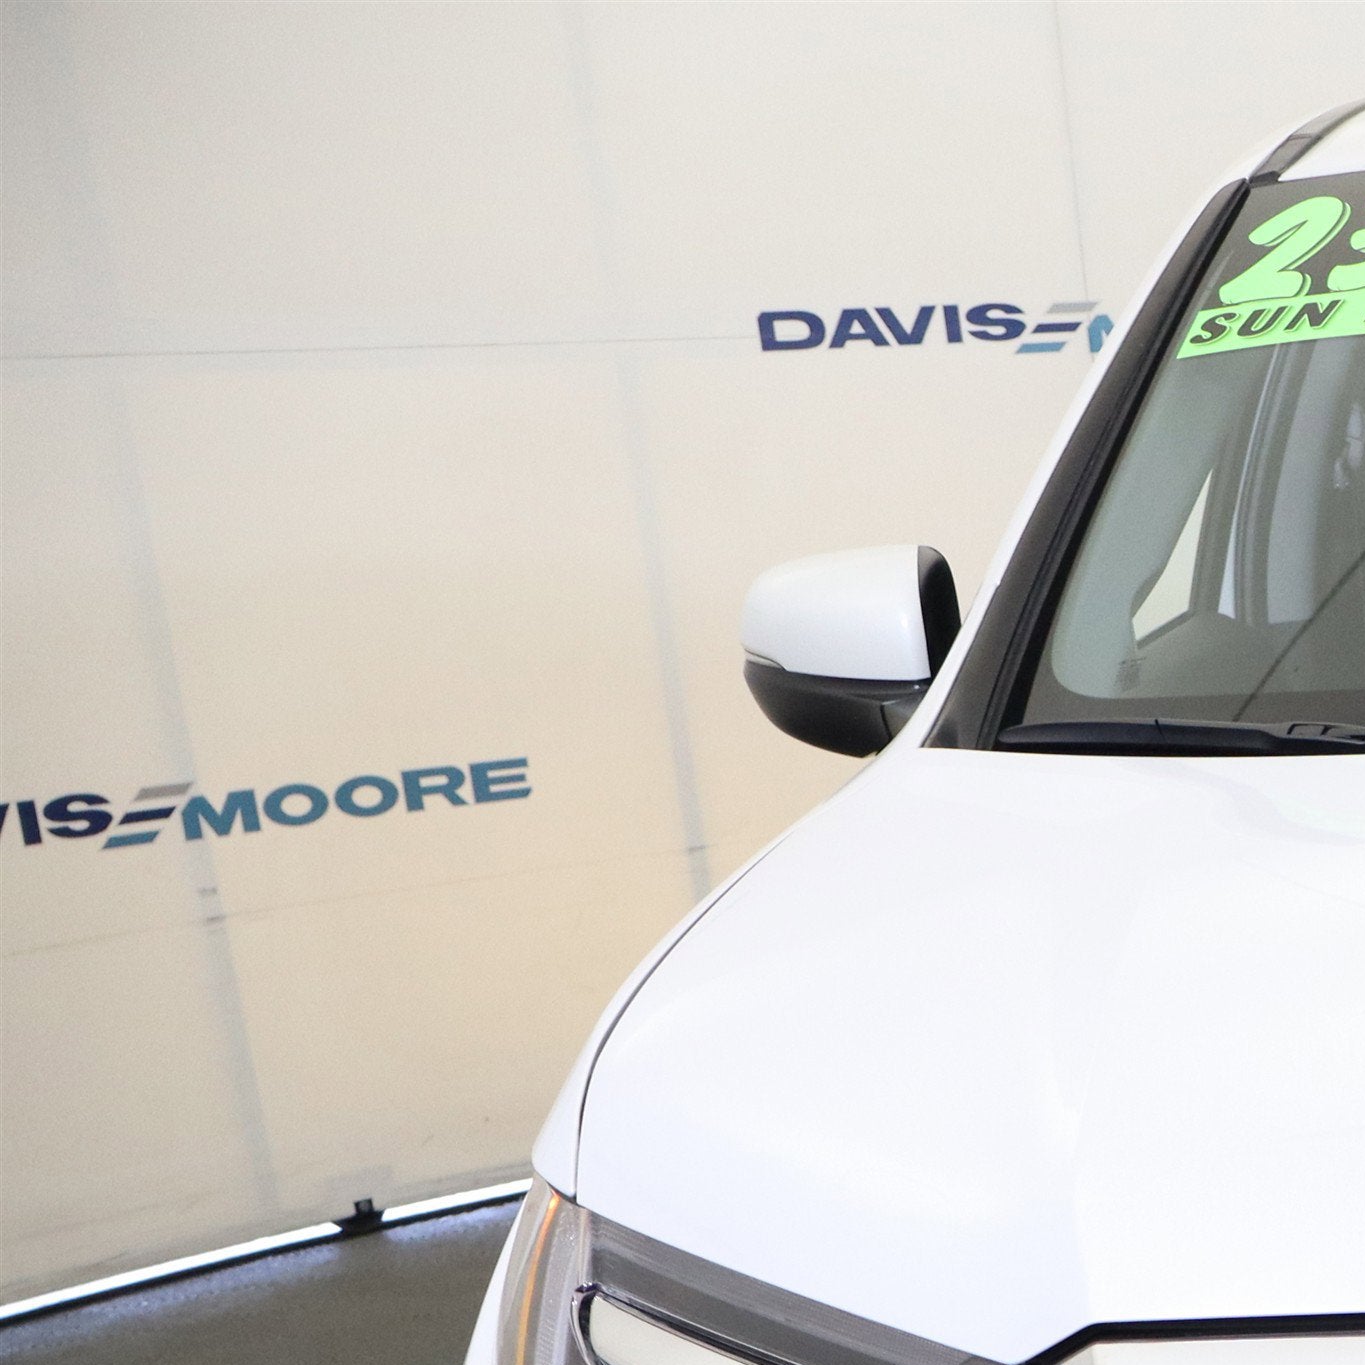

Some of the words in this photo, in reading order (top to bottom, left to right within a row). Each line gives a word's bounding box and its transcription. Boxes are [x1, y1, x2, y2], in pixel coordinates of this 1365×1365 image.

[758, 303, 1026, 351] DAVIS
[1189, 299, 1341, 346] SUN
[0, 793, 113, 846] IS
[181, 757, 532, 841] MOORE
